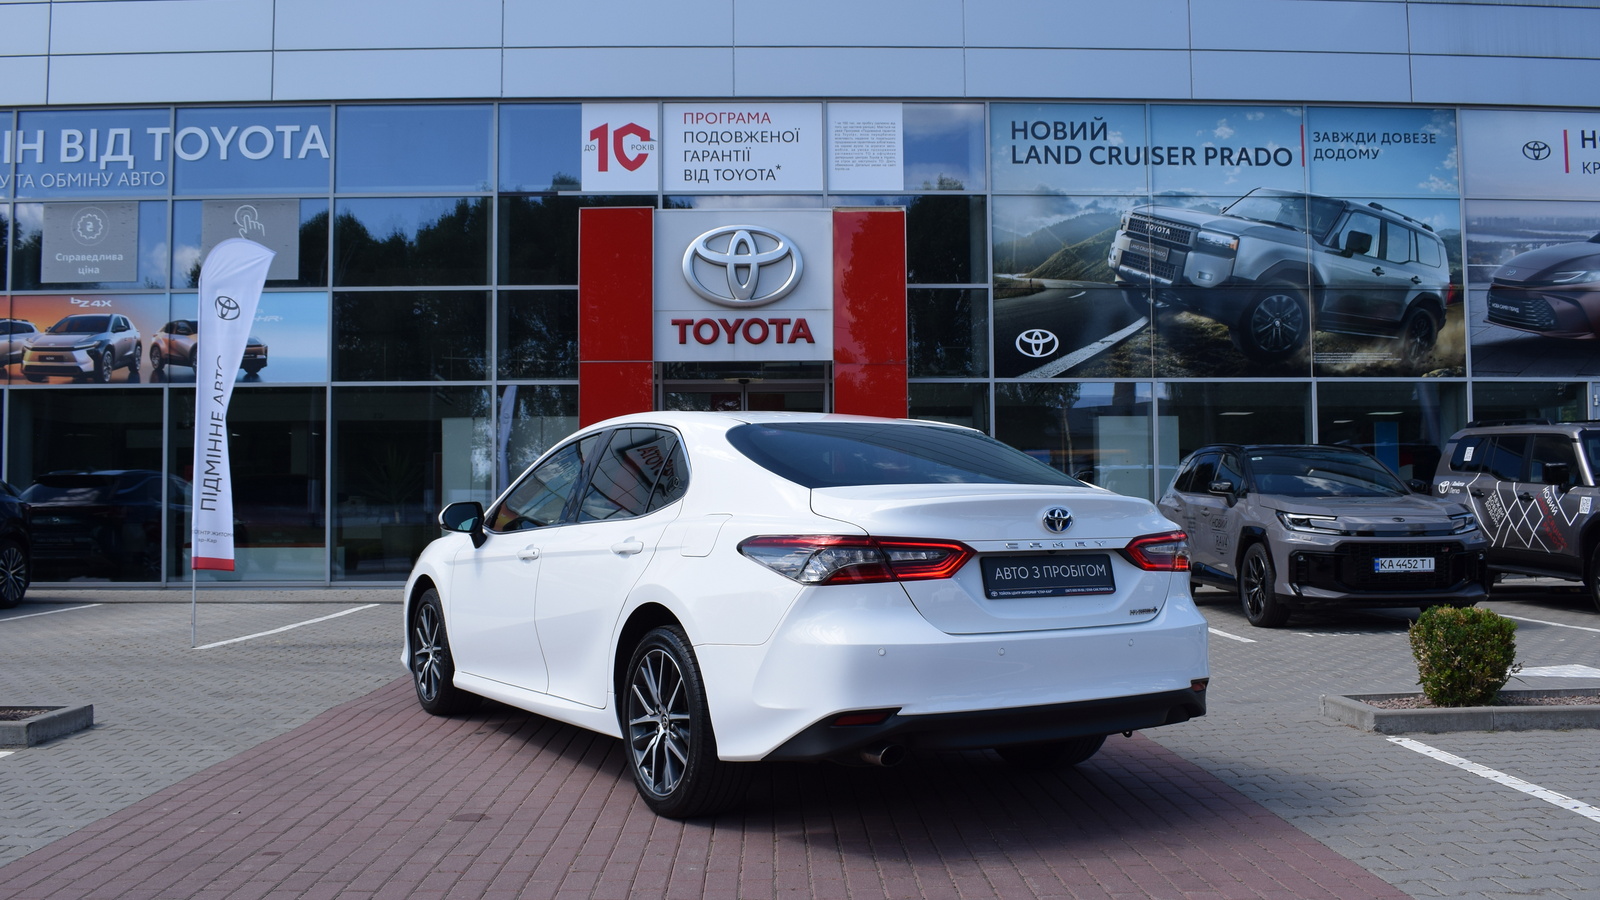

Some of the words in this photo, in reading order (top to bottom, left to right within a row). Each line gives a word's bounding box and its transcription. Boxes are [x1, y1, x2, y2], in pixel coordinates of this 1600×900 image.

[683, 112, 771, 125] ПРОГРАМА
[1011, 116, 1108, 141] НОВИЙ
[683, 128, 800, 146] ПОДОВЖЕНОЇ
[1313, 131, 1377, 144] ЗАВЖДИ
[1380, 132, 1437, 145] ДОВЕЗЕ
[1581, 130, 1600, 149] Н
[60, 127, 134, 170] ВІД
[147, 124, 330, 162] TOYOTA
[583, 144, 597, 152] ДО
[683, 147, 751, 162] ГАРАНТІЇ
[1313, 148, 1380, 161] ДОДОМУ
[1011, 145, 1082, 165] LAND
[1089, 146, 1196, 166] CRUISER
[1204, 147, 1293, 167] PRADO
[15, 174, 35, 188] ТА
[40, 173, 114, 188] ОБМІНУ
[117, 171, 165, 186] АВТО
[683, 169, 709, 184] ВІД
[1145, 223, 1171, 235] TOYOTA
[55, 253, 124, 264] Справедлива
[77, 266, 100, 277] ціна
[70, 297, 112, 307] bZ4X
[671, 318, 815, 344] TOYOTA
[200, 411, 225, 511] ПІДМІННЕ
[1542, 486, 1559, 516] НОВИЙ
[1005, 541, 1106, 549] CAMRY
[1396, 559, 1418, 569] 4452
[995, 567, 1029, 581] АВТО
[1031, 566, 1041, 579] З
[1043, 564, 1107, 579] ПРОБІГОМ
